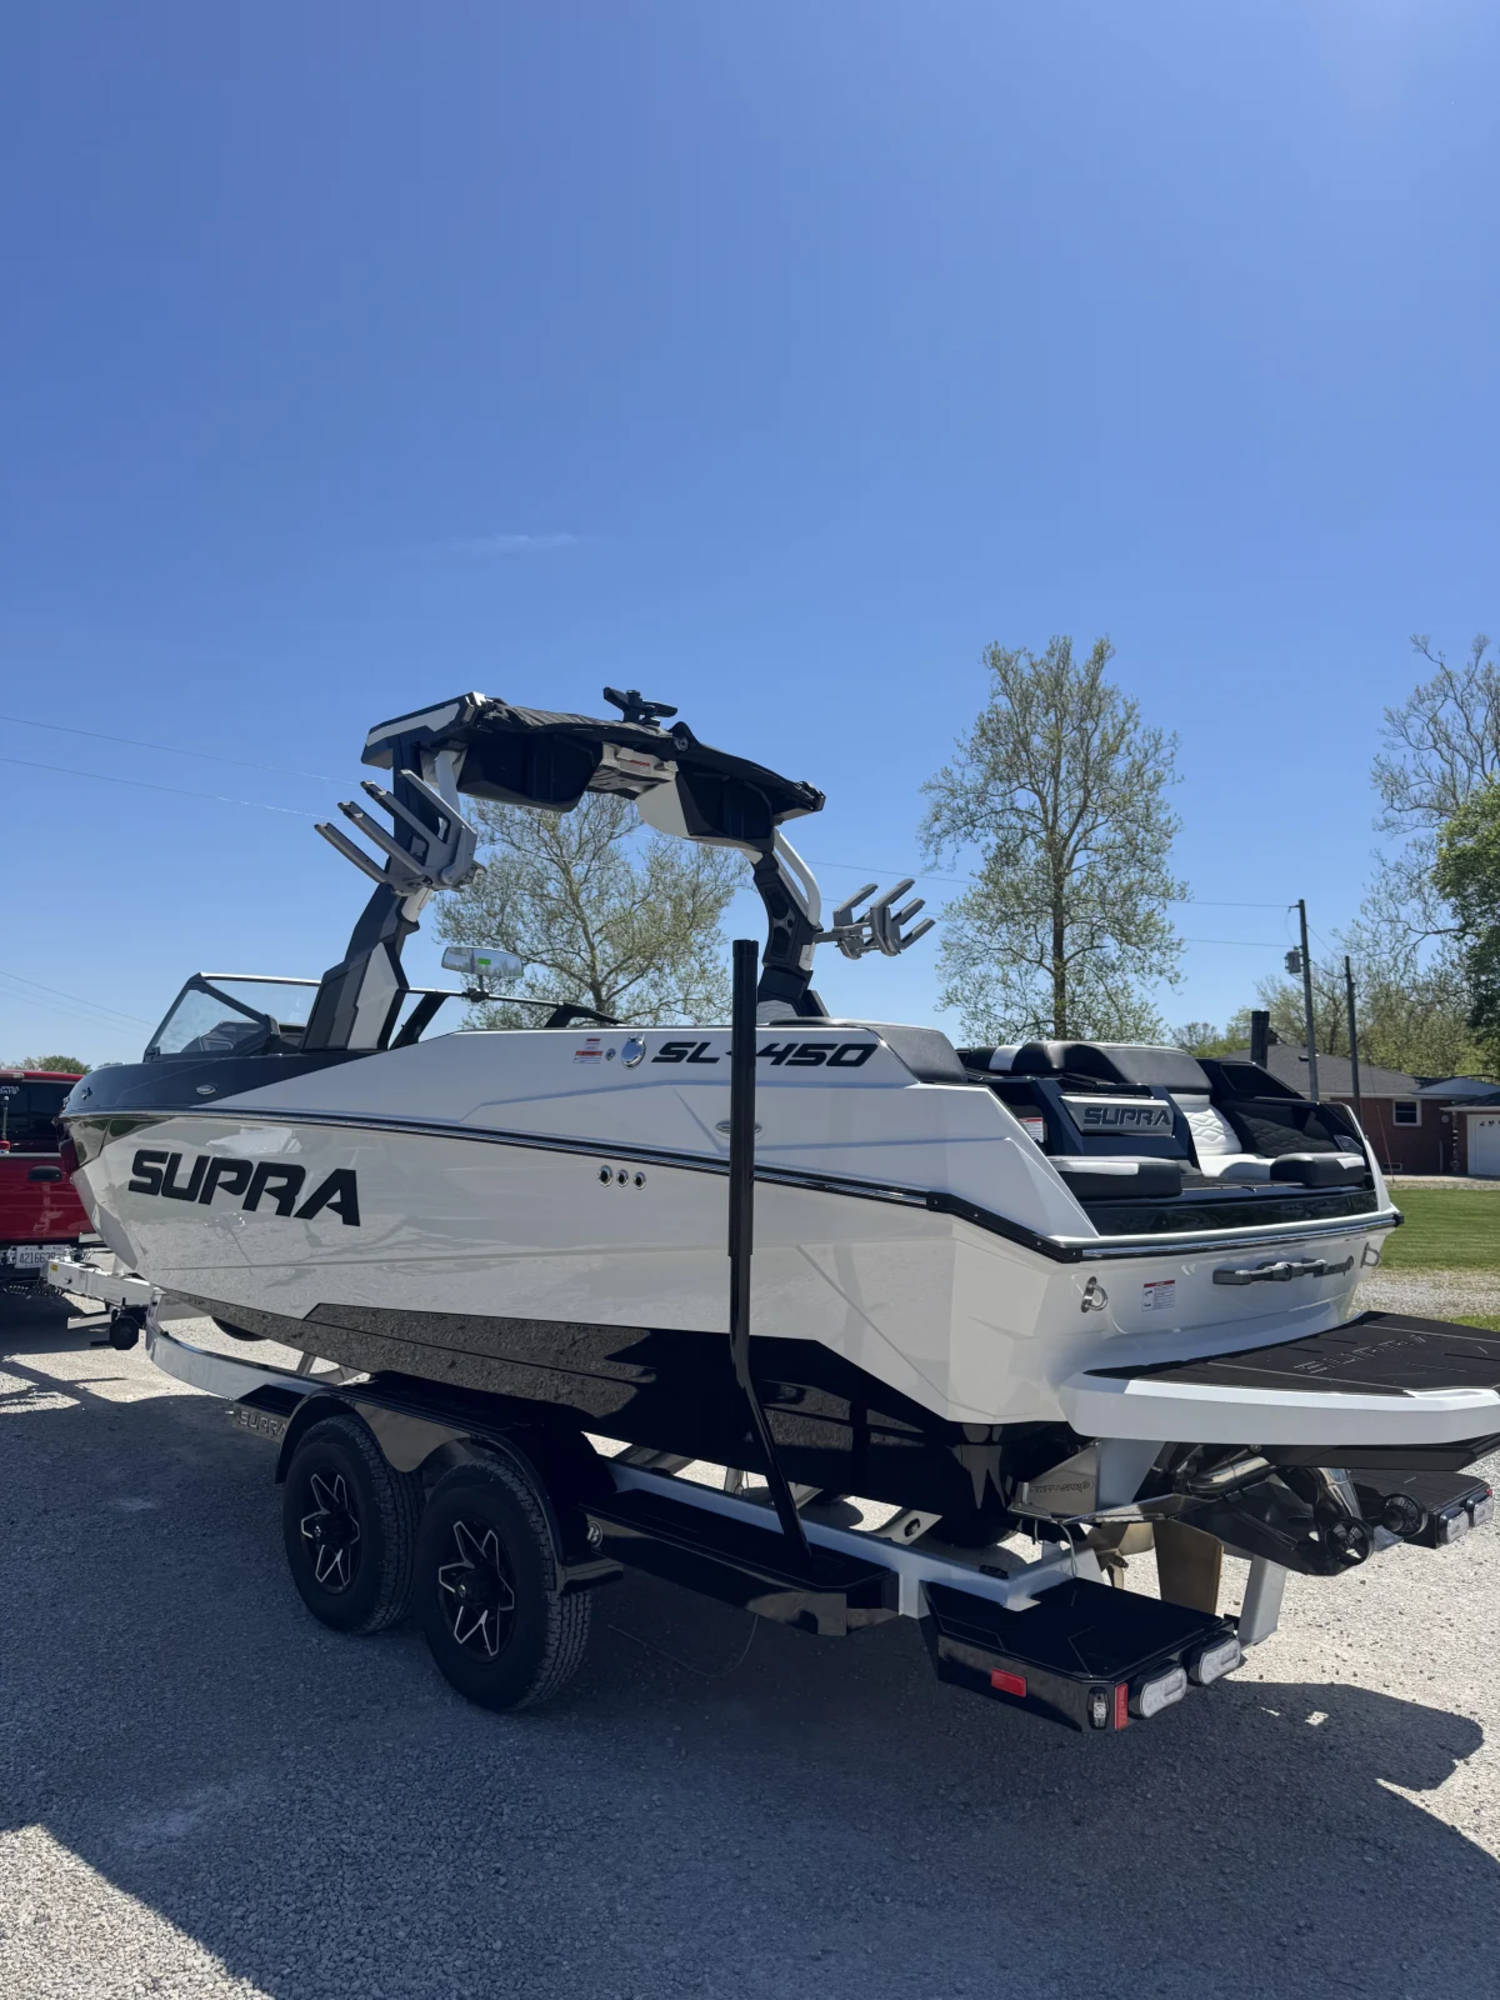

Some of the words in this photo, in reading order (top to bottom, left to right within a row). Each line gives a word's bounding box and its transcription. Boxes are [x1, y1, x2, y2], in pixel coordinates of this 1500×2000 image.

[1083, 1106, 1171, 1127] SUPRA
[128, 1149, 361, 1227] SUPRA
[238, 1410, 287, 1436] SUPRA
